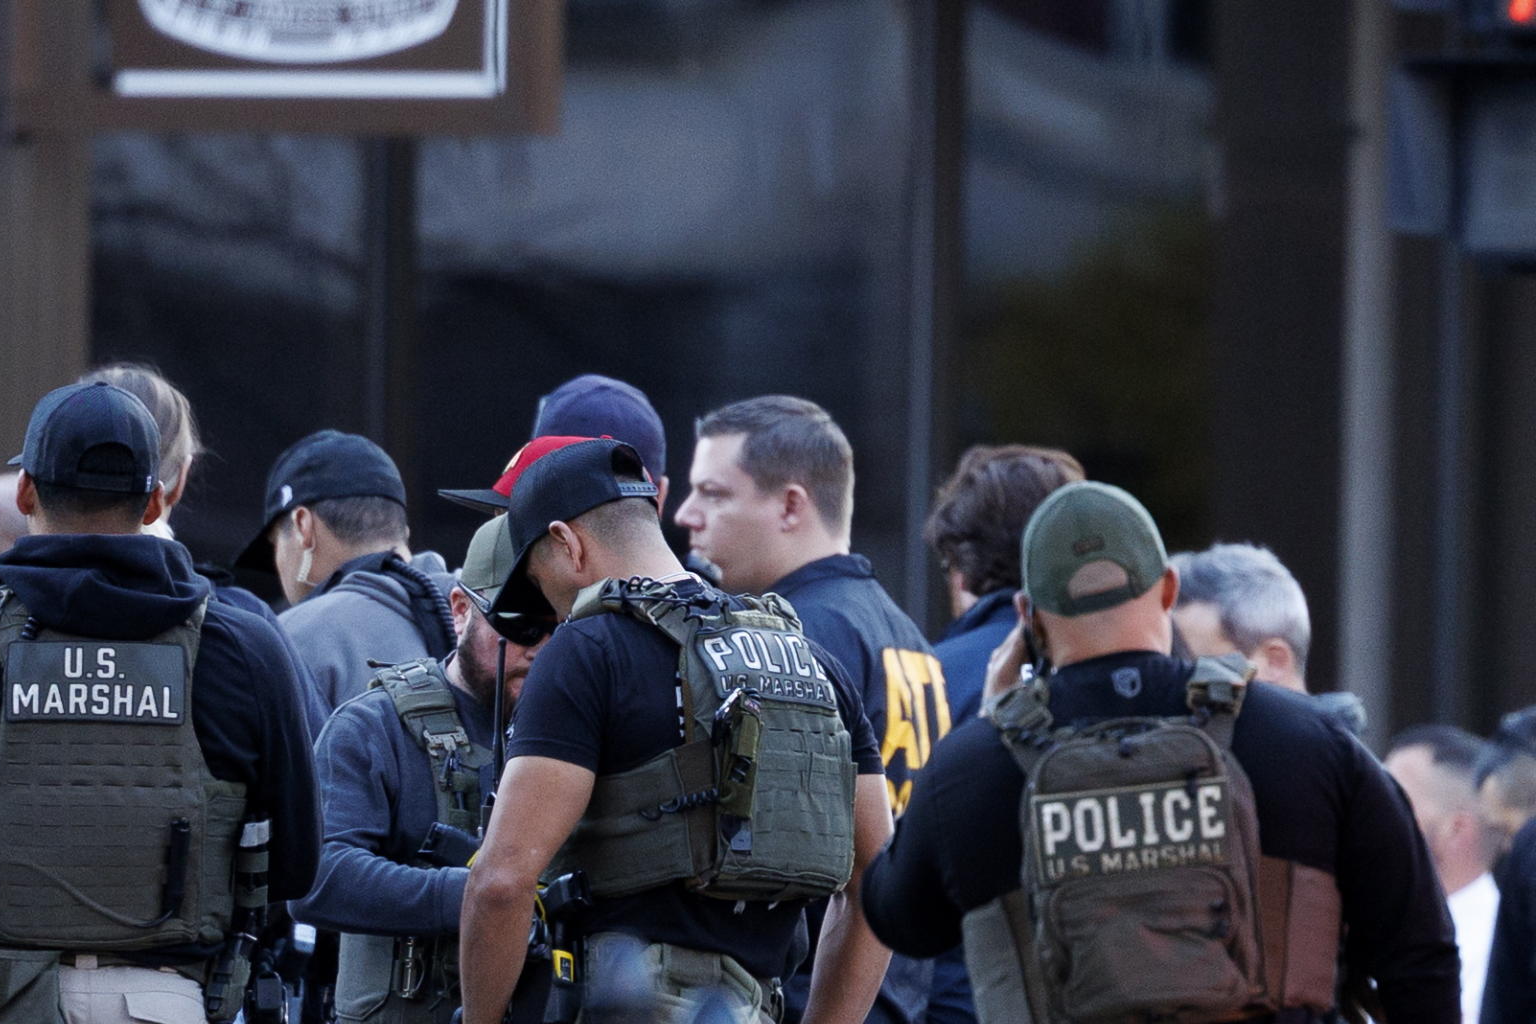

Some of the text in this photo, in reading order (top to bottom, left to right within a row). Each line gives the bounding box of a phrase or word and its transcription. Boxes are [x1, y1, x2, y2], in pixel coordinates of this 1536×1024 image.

[64, 647, 125, 679] U.S.
[13, 683, 178, 719] MARSHAL
[759, 676, 835, 704] MARSHAL
[1041, 785, 1225, 856] POLICE
